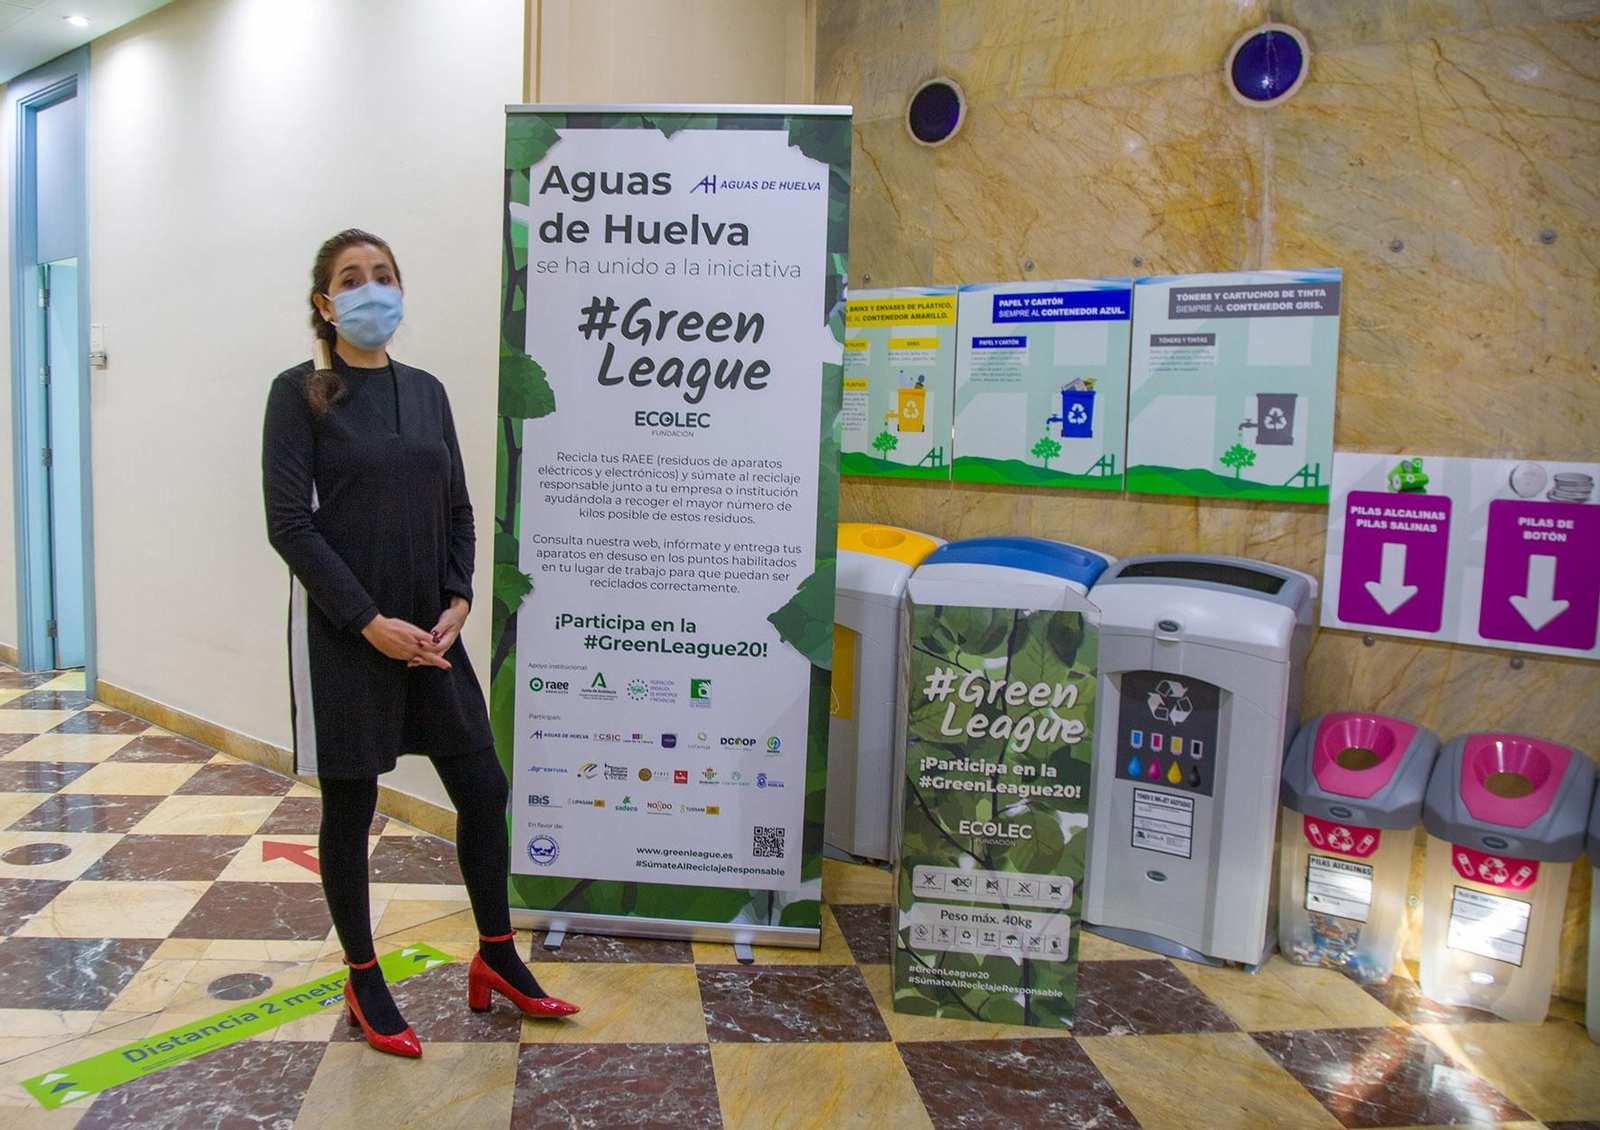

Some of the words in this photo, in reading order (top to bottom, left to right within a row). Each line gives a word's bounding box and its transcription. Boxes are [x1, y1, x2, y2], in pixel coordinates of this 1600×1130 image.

[539, 165, 672, 202] Aguas
[720, 179, 759, 190] AGUAS
[761, 180, 776, 190] DE
[778, 181, 821, 191] HUELVA
[539, 212, 590, 244] de
[604, 213, 749, 246] Huelva
[536, 260, 559, 274] se
[565, 256, 590, 274] ha
[597, 257, 658, 276] unido
[665, 262, 675, 276] a
[684, 258, 700, 276] la
[708, 259, 801, 278] iniciativa
[999, 299, 1022, 307] PAPEL
[1030, 297, 1064, 306] CARTÓN
[1176, 292, 1212, 301] TÓNERS
[1222, 290, 1280, 300] CARTUCHOS
[1281, 290, 1295, 298] DE
[1297, 289, 1326, 297] TINTA
[876, 304, 905, 312] ENVASES
[998, 309, 1030, 318] SIEMPRE
[1030, 309, 1041, 317] AL
[1041, 307, 1098, 316] CONTENEDOR
[1099, 306, 1125, 315] AZUL.
[1175, 304, 1212, 314] SIEMPRE
[1214, 304, 1225, 312] AL
[1226, 302, 1294, 312] CONTENEDOR
[1295, 301, 1323, 310] GRIS.
[578, 295, 765, 346] #Green
[862, 314, 909, 322] CONTENEDOR
[910, 312, 948, 320] AMARILLO.
[1158, 336, 1181, 344] TÓNERS
[1187, 336, 1208, 344] TINTAS
[597, 342, 771, 405] League
[635, 411, 711, 428] ECOLEC
[651, 429, 694, 438] FUNDACIÓN
[556, 451, 597, 462] Recicla
[600, 453, 619, 463] tus
[621, 453, 653, 464] RAEE
[656, 454, 710, 466] (residuos
[712, 456, 728, 467] de
[730, 458, 783, 469] aparatos
[537, 464, 593, 476] eléctricos
[594, 468, 603, 478] y
[604, 466, 679, 481] electrónicos)
[681, 471, 689, 481] y
[690, 469, 736, 481] súmate
[738, 470, 749, 482] al
[752, 472, 801, 485] reciclaje
[539, 480, 609, 491] responsable
[609, 481, 643, 493] junto
[644, 484, 652, 492] a
[654, 483, 668, 493] tu
[670, 485, 722, 495] empresa
[724, 486, 733, 495] o
[735, 484, 798, 497] institución
[544, 493, 612, 505] ayudándola
[614, 496, 622, 505] a
[624, 497, 670, 509] recoger
[672, 497, 682, 507] el
[685, 498, 723, 510] mayor
[726, 499, 774, 511] número
[776, 500, 792, 511] de
[578, 507, 605, 518] kilos
[607, 509, 650, 520] posible
[651, 510, 667, 520] de
[669, 512, 701, 522] estos
[703, 512, 756, 524] residuos.
[1350, 505, 1382, 517] PILAS
[1383, 507, 1446, 521] ALCALINAS
[1356, 518, 1388, 530] PILAS
[1390, 521, 1438, 533] SALINAS
[1518, 517, 1554, 528] PILAS
[1557, 519, 1574, 529] DE
[532, 533, 583, 545] Consulta
[586, 537, 630, 547] nuestra
[632, 537, 661, 549] web,
[663, 538, 721, 551] infórmate
[723, 542, 731, 553] y
[733, 542, 780, 555] entrega
[782, 544, 802, 554] tus
[1523, 530, 1567, 543] BOTÓN
[535, 549, 586, 560] aparatos
[588, 551, 603, 560] en
[606, 550, 648, 562] desuso
[650, 553, 665, 562] en
[668, 552, 685, 563] los
[687, 555, 729, 565] puntos
[731, 554, 797, 568] habilitados
[541, 563, 556, 571] en
[559, 563, 571, 572] tu
[574, 562, 605, 575] lugar
[606, 563, 622, 576] de
[624, 565, 666, 578] trabajo
[669, 568, 695, 578] para
[697, 569, 723, 580] que
[723, 569, 769, 581] puedan
[772, 572, 790, 581] ser
[589, 577, 648, 589] reciclados
[649, 580, 740, 593] correctamente.
[555, 613, 645, 633] ¡Participa
[651, 620, 675, 632] en
[681, 618, 696, 633] la
[584, 635, 768, 659] #GreenLeague20!
[528, 662, 548, 670] Apoyo
[545, 681, 569, 690] raee
[923, 666, 1079, 709] #Green
[940, 702, 1084, 754] League
[599, 733, 621, 741] CSIC
[920, 756, 1008, 776] ¡Participa
[1013, 764, 1035, 777] en
[1041, 762, 1057, 778] la
[919, 775, 1082, 799] #GreenLeague20!
[959, 820, 1032, 840] ECOLEC
[636, 847, 733, 861] www.greenleague.es
[636, 860, 786, 877] #SúmateAlReciclajeResponsable
[1311, 857, 1331, 867] PILAS
[1333, 861, 1372, 875] ALCALINAS
[940, 909, 968, 922] Peso
[971, 913, 999, 925] máx.
[1003, 915, 1032, 929] 40kg
[908, 965, 990, 980] #GreenLeague20
[908, 976, 1063, 998] #SúmateAlReciclajeResponsable
[122, 1011, 260, 1063] Distancia
[259, 1001, 282, 1015] 2
[285, 976, 348, 1006] metr
